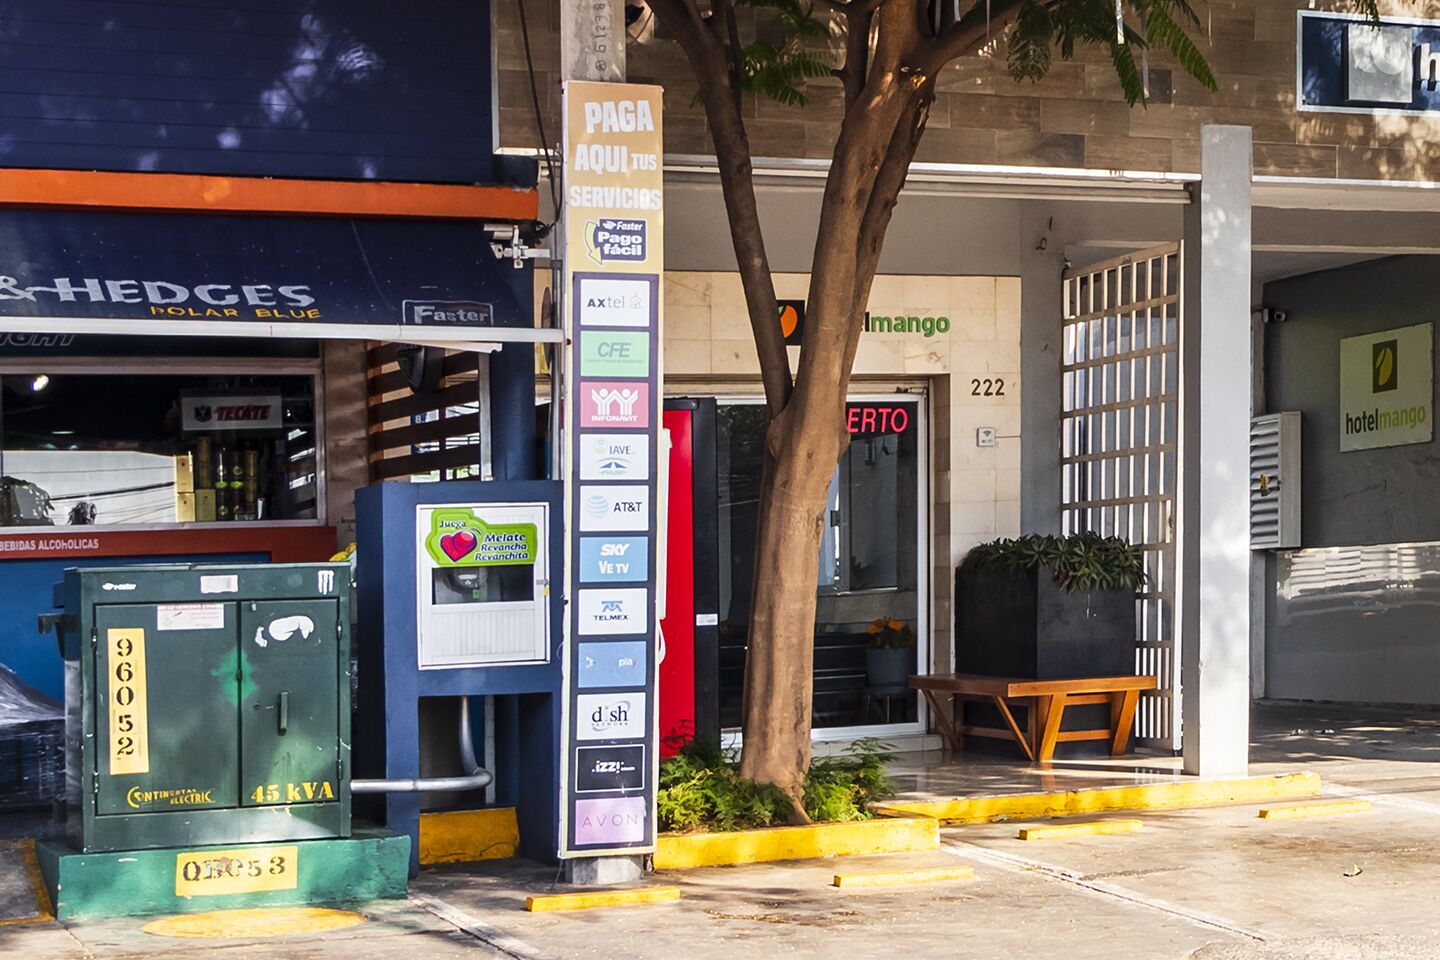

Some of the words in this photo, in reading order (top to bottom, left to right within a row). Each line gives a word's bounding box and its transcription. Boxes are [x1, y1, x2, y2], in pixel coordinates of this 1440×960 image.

[584, 100, 654, 134] PAGA
[574, 144, 627, 174] AQUI
[631, 153, 657, 170] TUS
[570, 185, 662, 210] SERVICIOS
[616, 220, 643, 231] Faster
[598, 231, 643, 246] Pago
[602, 242, 643, 256] fácil
[54, 278, 316, 307] HEDGES
[150, 306, 239, 318] POLAR
[255, 308, 322, 320] BLUE
[414, 305, 489, 324] Faster
[597, 342, 632, 358] CFE
[971, 378, 1005, 396] 222
[1345, 405, 1426, 435] hotelmango
[613, 502, 643, 513] AT&T
[440, 520, 467, 529] Juega
[0, 540, 36, 551] BEBIDAS
[485, 534, 526, 543] Melate
[480, 543, 527, 552] Revancha
[600, 543, 630, 556] SKY
[475, 552, 528, 561] Revanchita
[592, 705, 629, 723] dish
[251, 785, 280, 803] 45
[287, 781, 334, 802] kVA
[582, 814, 638, 828] AVON
